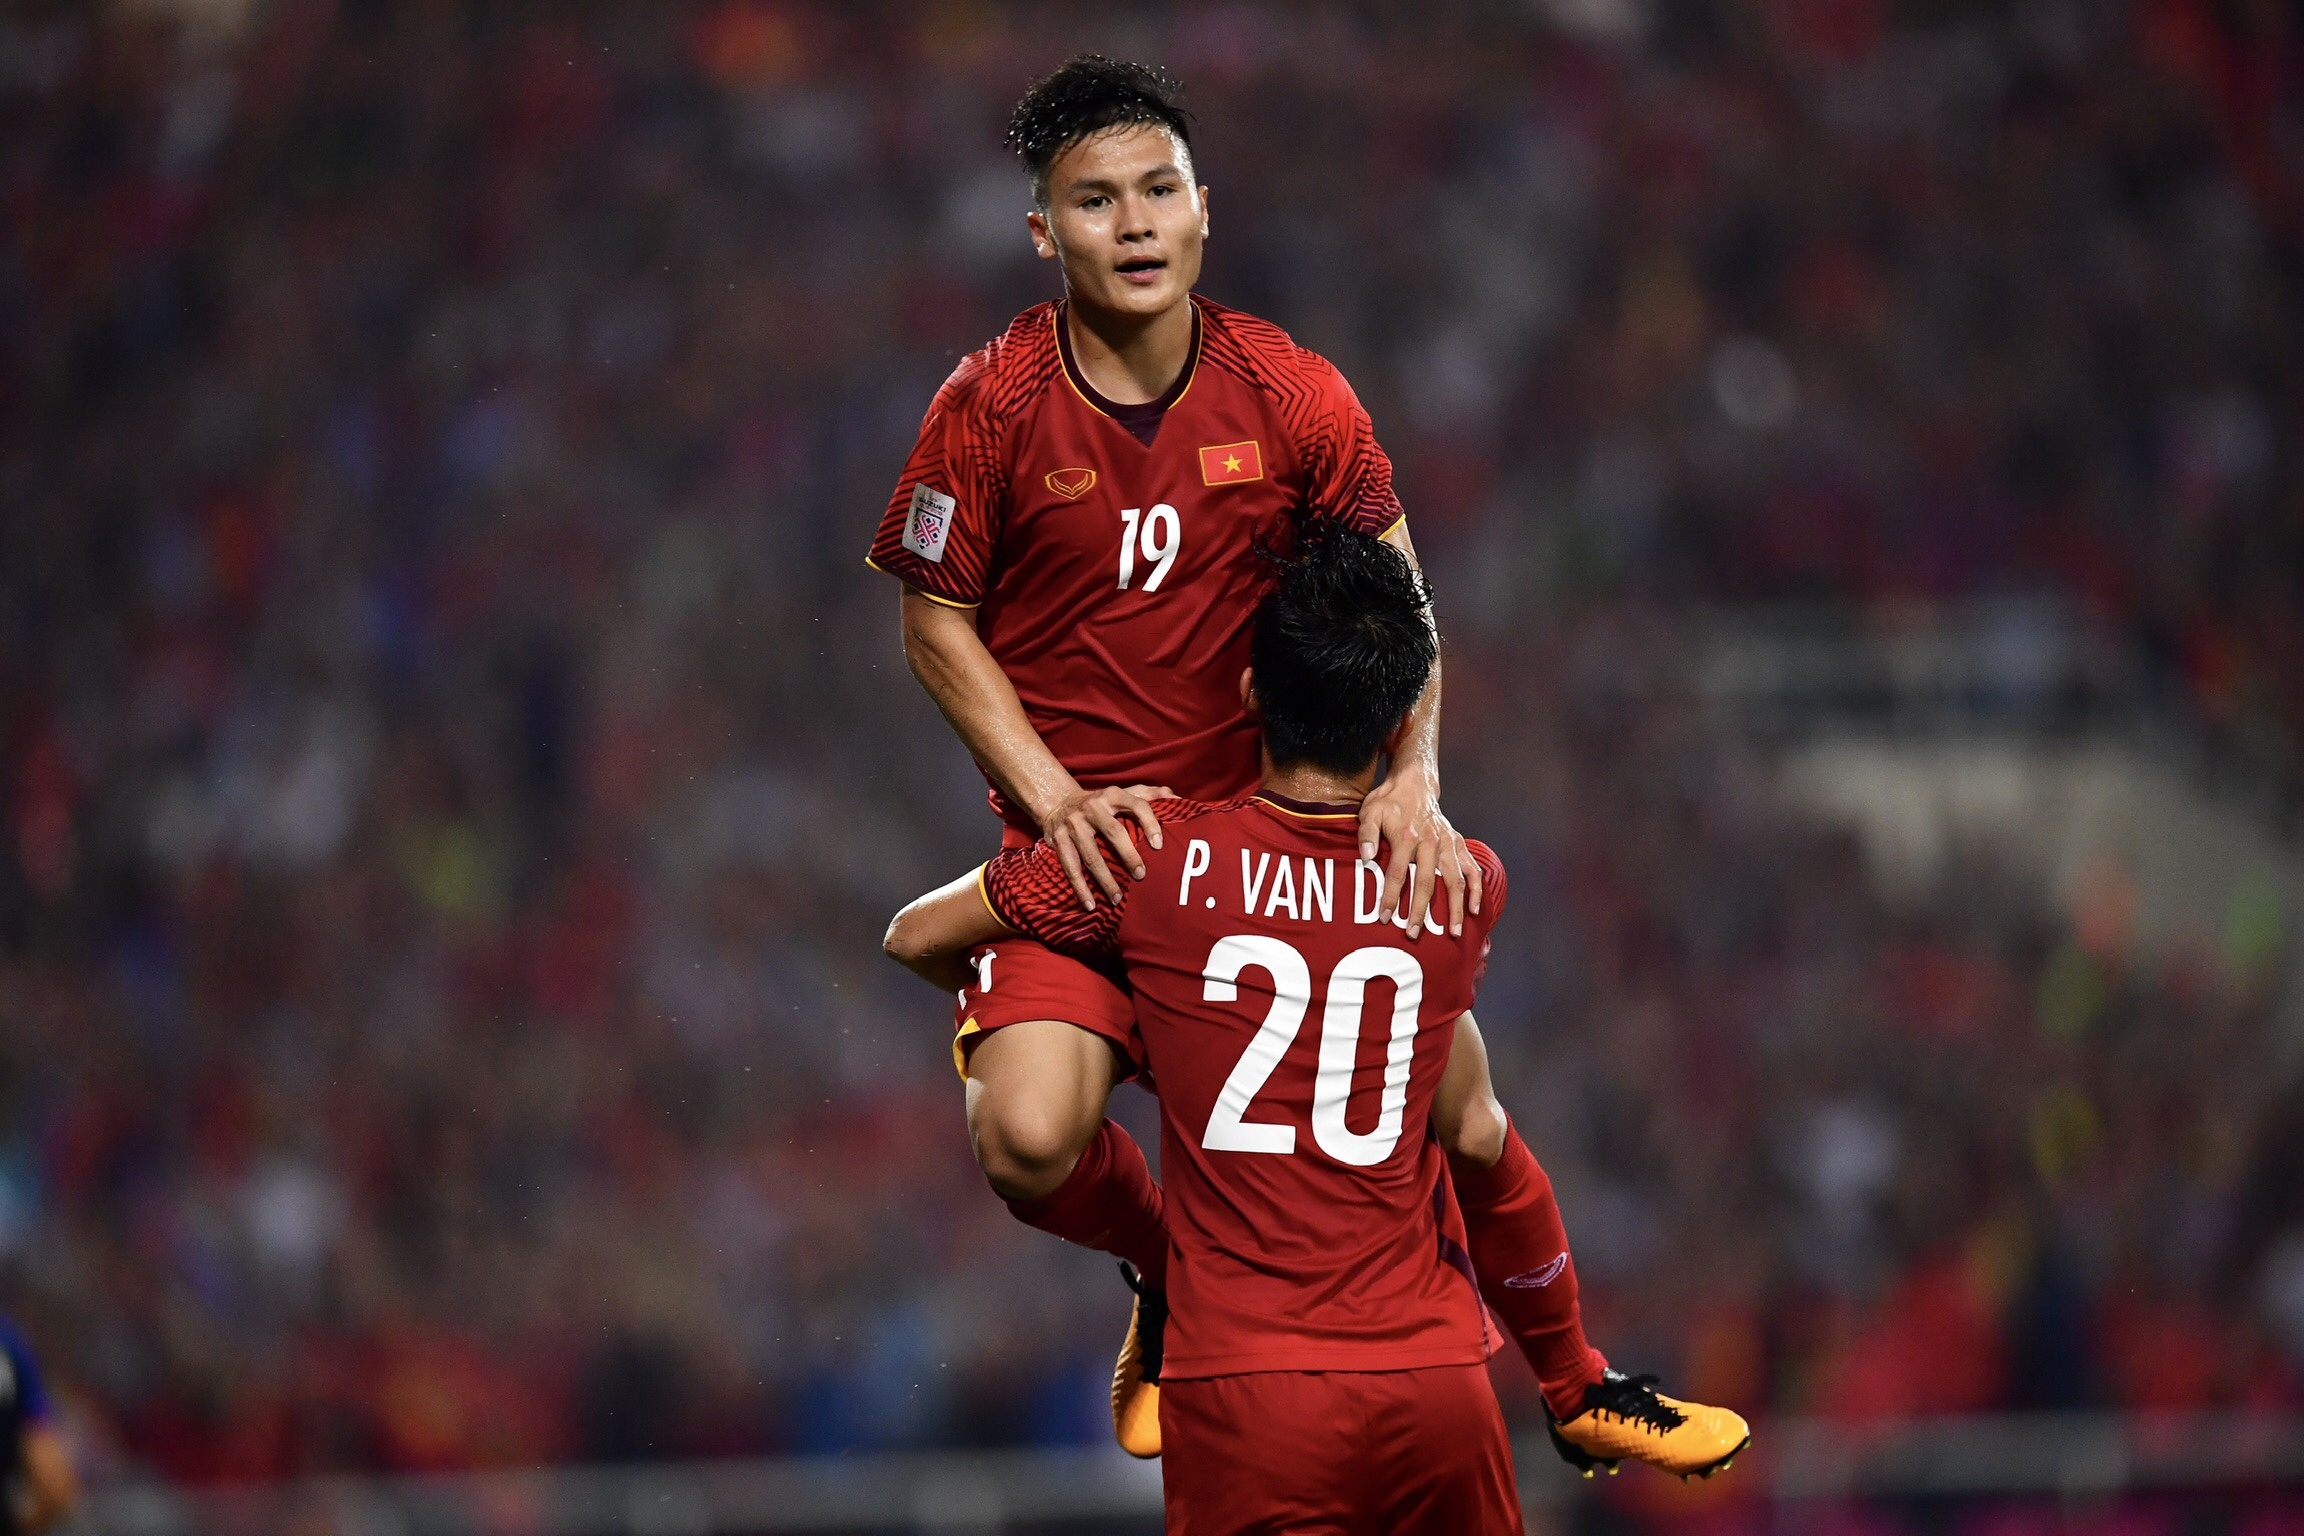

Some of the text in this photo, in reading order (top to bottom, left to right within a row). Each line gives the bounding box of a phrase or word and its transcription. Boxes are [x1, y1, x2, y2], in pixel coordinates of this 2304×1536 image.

[1116, 503, 1181, 593] 19
[1178, 839, 1216, 909] P.
[1240, 848, 1335, 922] VAN
[1202, 934, 1424, 1167] 20
